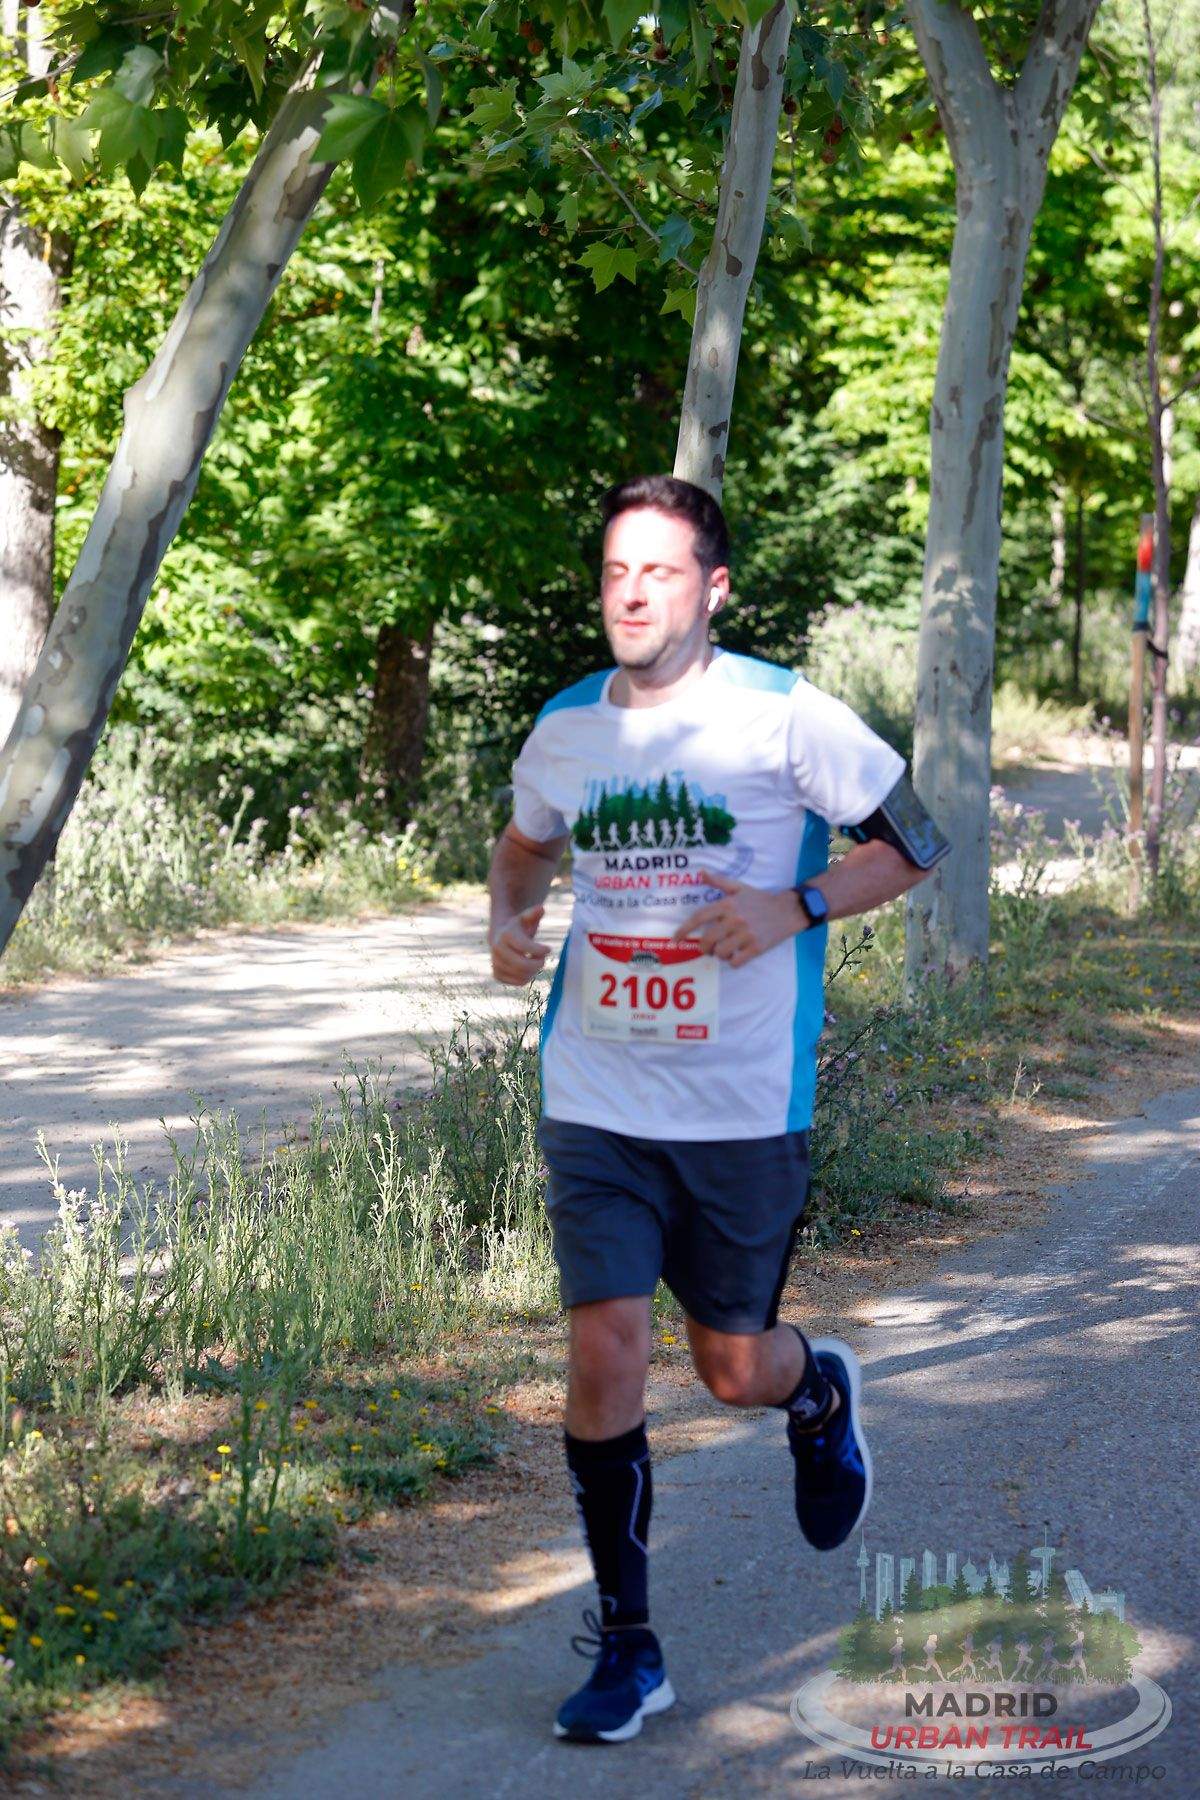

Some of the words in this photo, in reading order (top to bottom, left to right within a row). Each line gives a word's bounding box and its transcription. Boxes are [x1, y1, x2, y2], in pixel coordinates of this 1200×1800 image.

[605, 855, 689, 871] MADRID
[594, 875, 650, 890] URBAN
[657, 871, 703, 888] TRAI
[600, 973, 697, 1012] 2106
